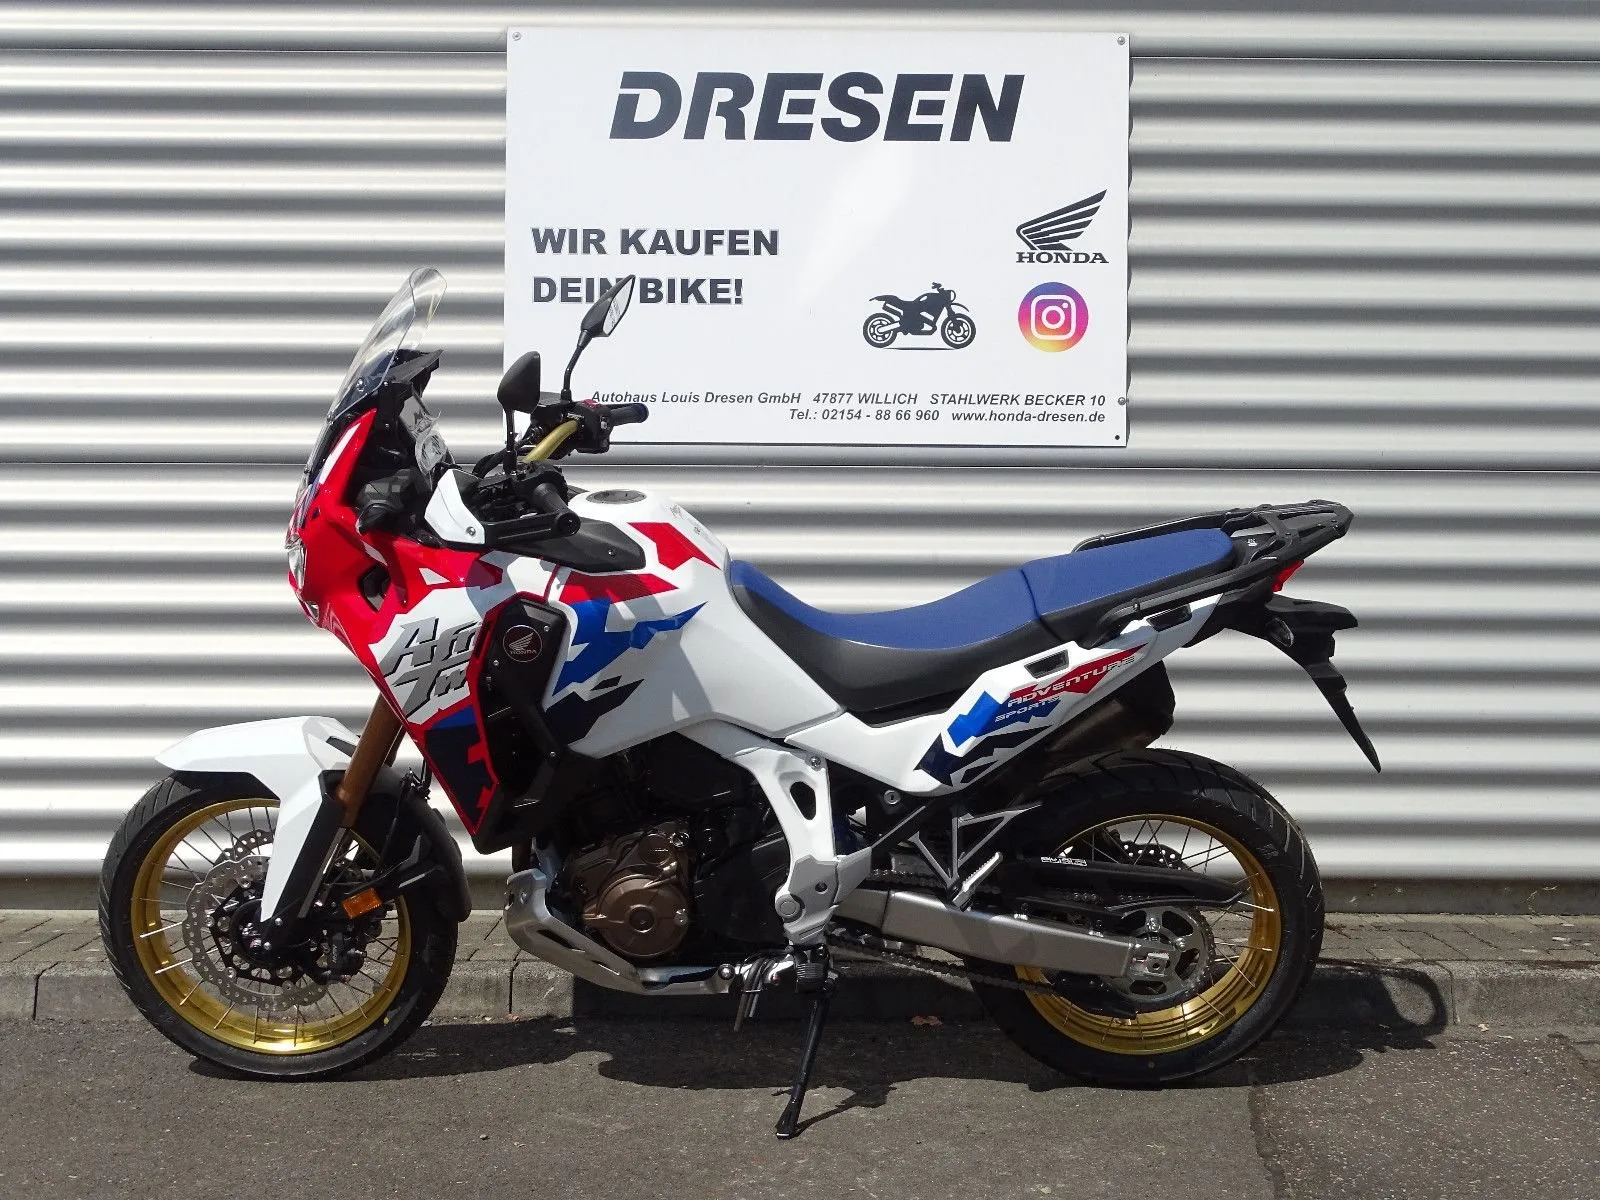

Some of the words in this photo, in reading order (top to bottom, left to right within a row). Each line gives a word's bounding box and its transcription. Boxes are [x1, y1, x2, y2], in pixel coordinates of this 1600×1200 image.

[610, 72, 1025, 142] DRESEN
[532, 228, 607, 254] WIR
[621, 229, 778, 255] KAUFEN
[1015, 251, 1110, 264] HONDA
[639, 278, 743, 304] BIKE!
[591, 391, 657, 403] Autohaus
[661, 391, 700, 403] Louis
[704, 392, 753, 404] Dresen
[757, 392, 802, 404] GmbH
[812, 392, 853, 404] 47877
[858, 393, 918, 405] WILLICH
[929, 393, 1020, 406] STAHLWERK
[1024, 394, 1086, 406] BECKER
[1090, 394, 1106, 406] 10
[789, 408, 817, 420] Tel.:
[821, 408, 862, 420] 02154
[875, 409, 891, 421] 88
[895, 409, 912, 421] 66
[915, 409, 940, 421] 960
[951, 410, 1106, 422] www.honda-dresen.de
[1007, 656, 1135, 708] ADVENTURE
[995, 695, 1060, 723] SPORTS
